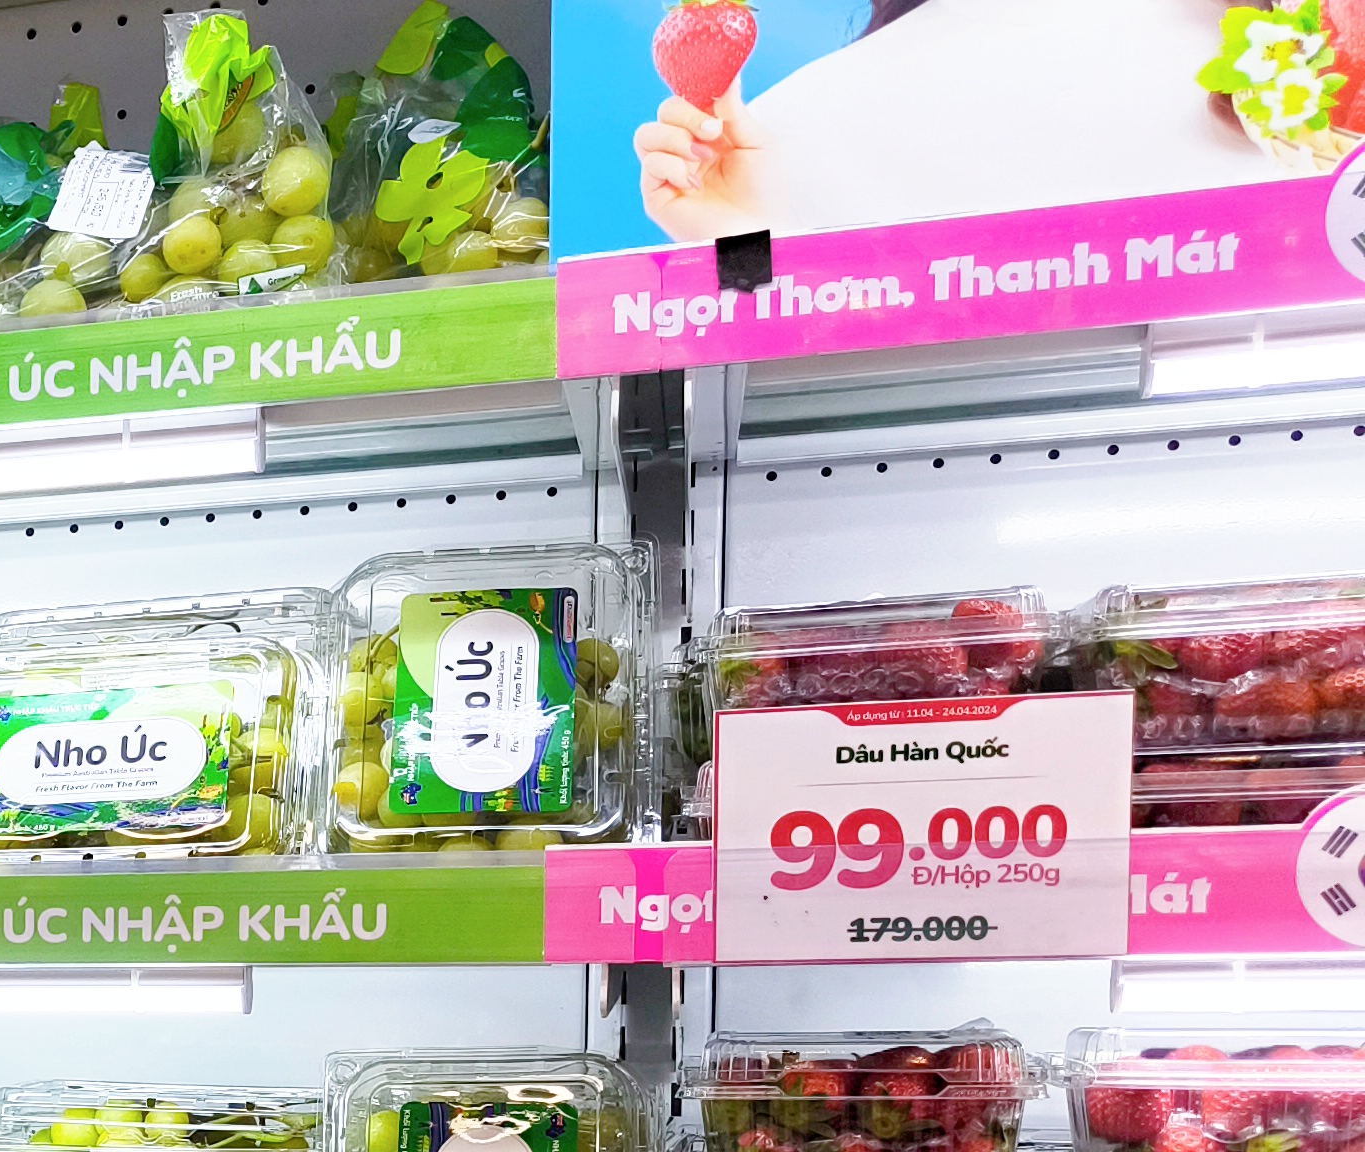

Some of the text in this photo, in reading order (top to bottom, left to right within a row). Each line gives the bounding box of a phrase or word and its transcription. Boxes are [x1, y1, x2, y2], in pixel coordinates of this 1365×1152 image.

[612, 230, 1240, 337] Ngọt Thơm, Thanh Mát
[9, 352, 75, 401] ÚC
[90, 336, 235, 398] NHẬP
[250, 316, 401, 380] KHẨU
[34, 725, 167, 769] Nho Úc
[836, 737, 1009, 763] Dâu Hàn Quốc
[770, 804, 1067, 891] 99.000
[911, 863, 1060, 889] Đ/Hộp 250g
[1130, 872, 1211, 914] át
[4, 897, 67, 943] ÚC
[82, 895, 224, 953] NHẬP
[239, 888, 387, 941] KHẨU
[848, 915, 997, 943] 179.000
